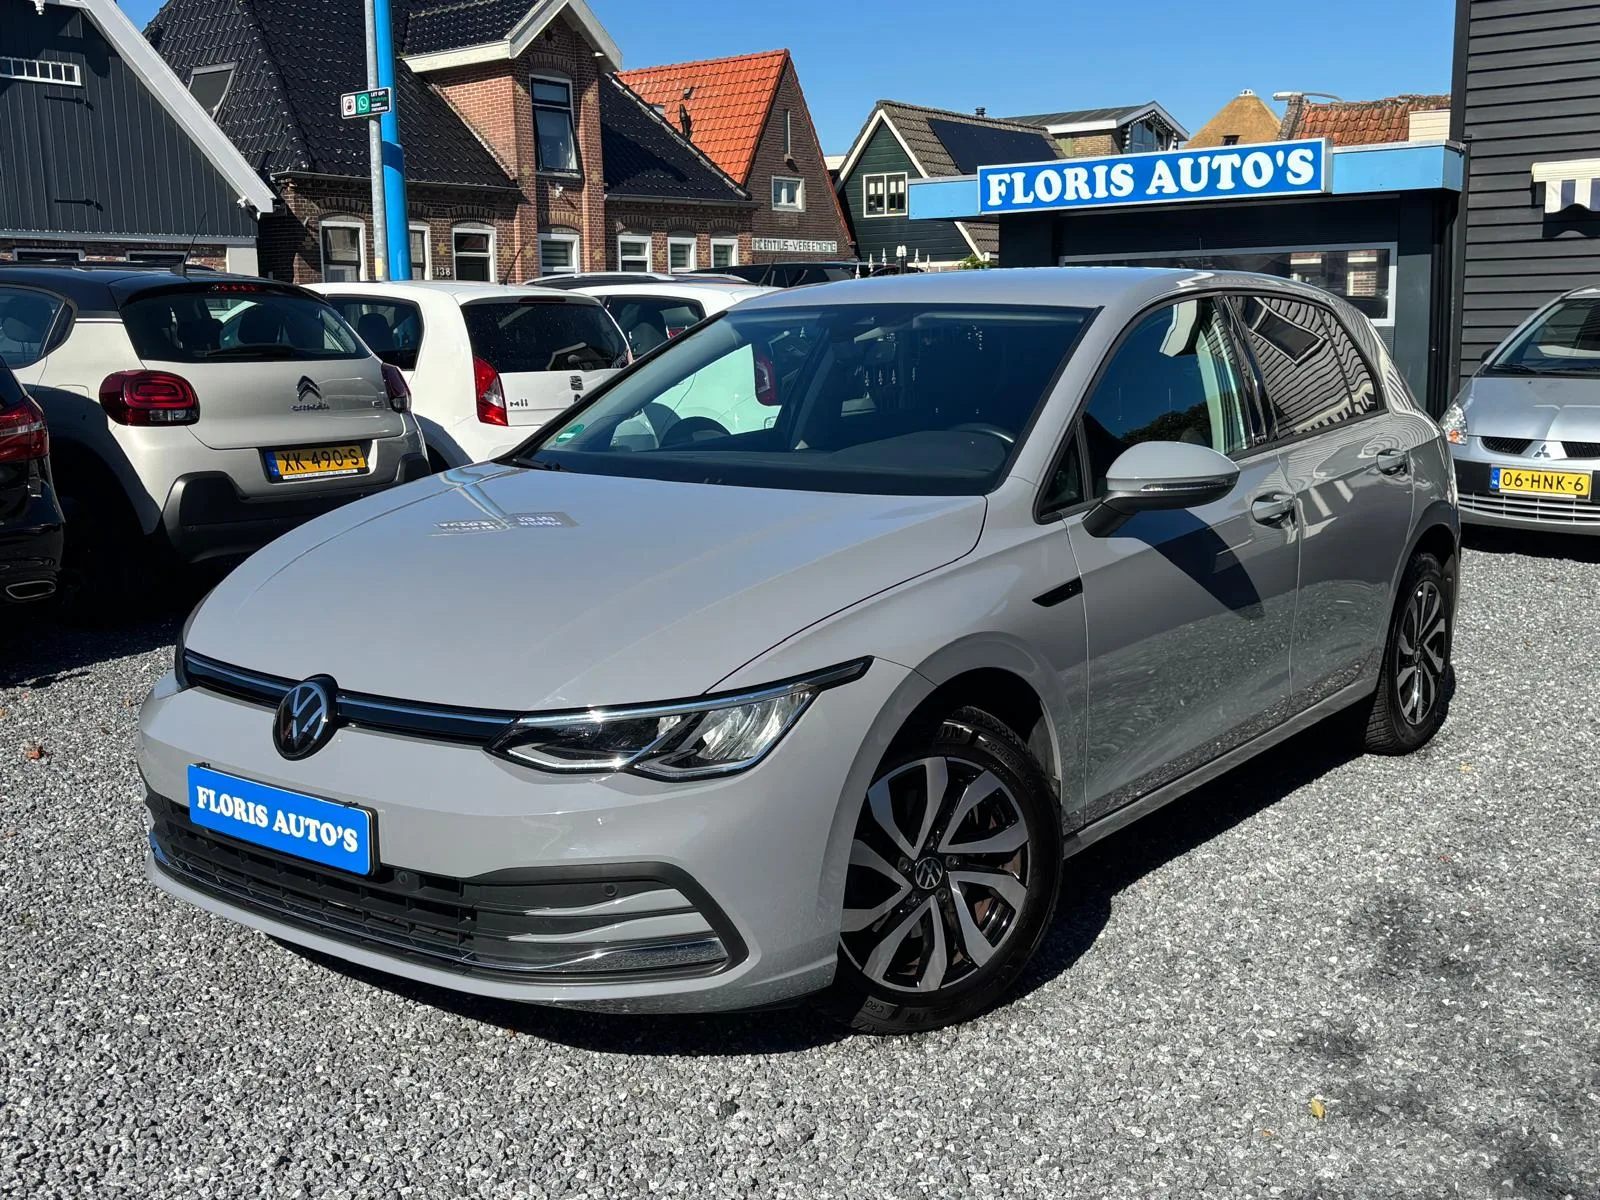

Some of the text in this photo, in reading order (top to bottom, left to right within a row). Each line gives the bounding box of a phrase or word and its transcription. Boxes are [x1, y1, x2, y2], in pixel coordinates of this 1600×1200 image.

[987, 149, 1314, 206] FLORIS AUTO'S
[436, 266, 451, 276] 138
[281, 449, 359, 471] XK-490-S
[1503, 472, 1584, 491] 06-HNK-6
[196, 785, 269, 828] FLORIS
